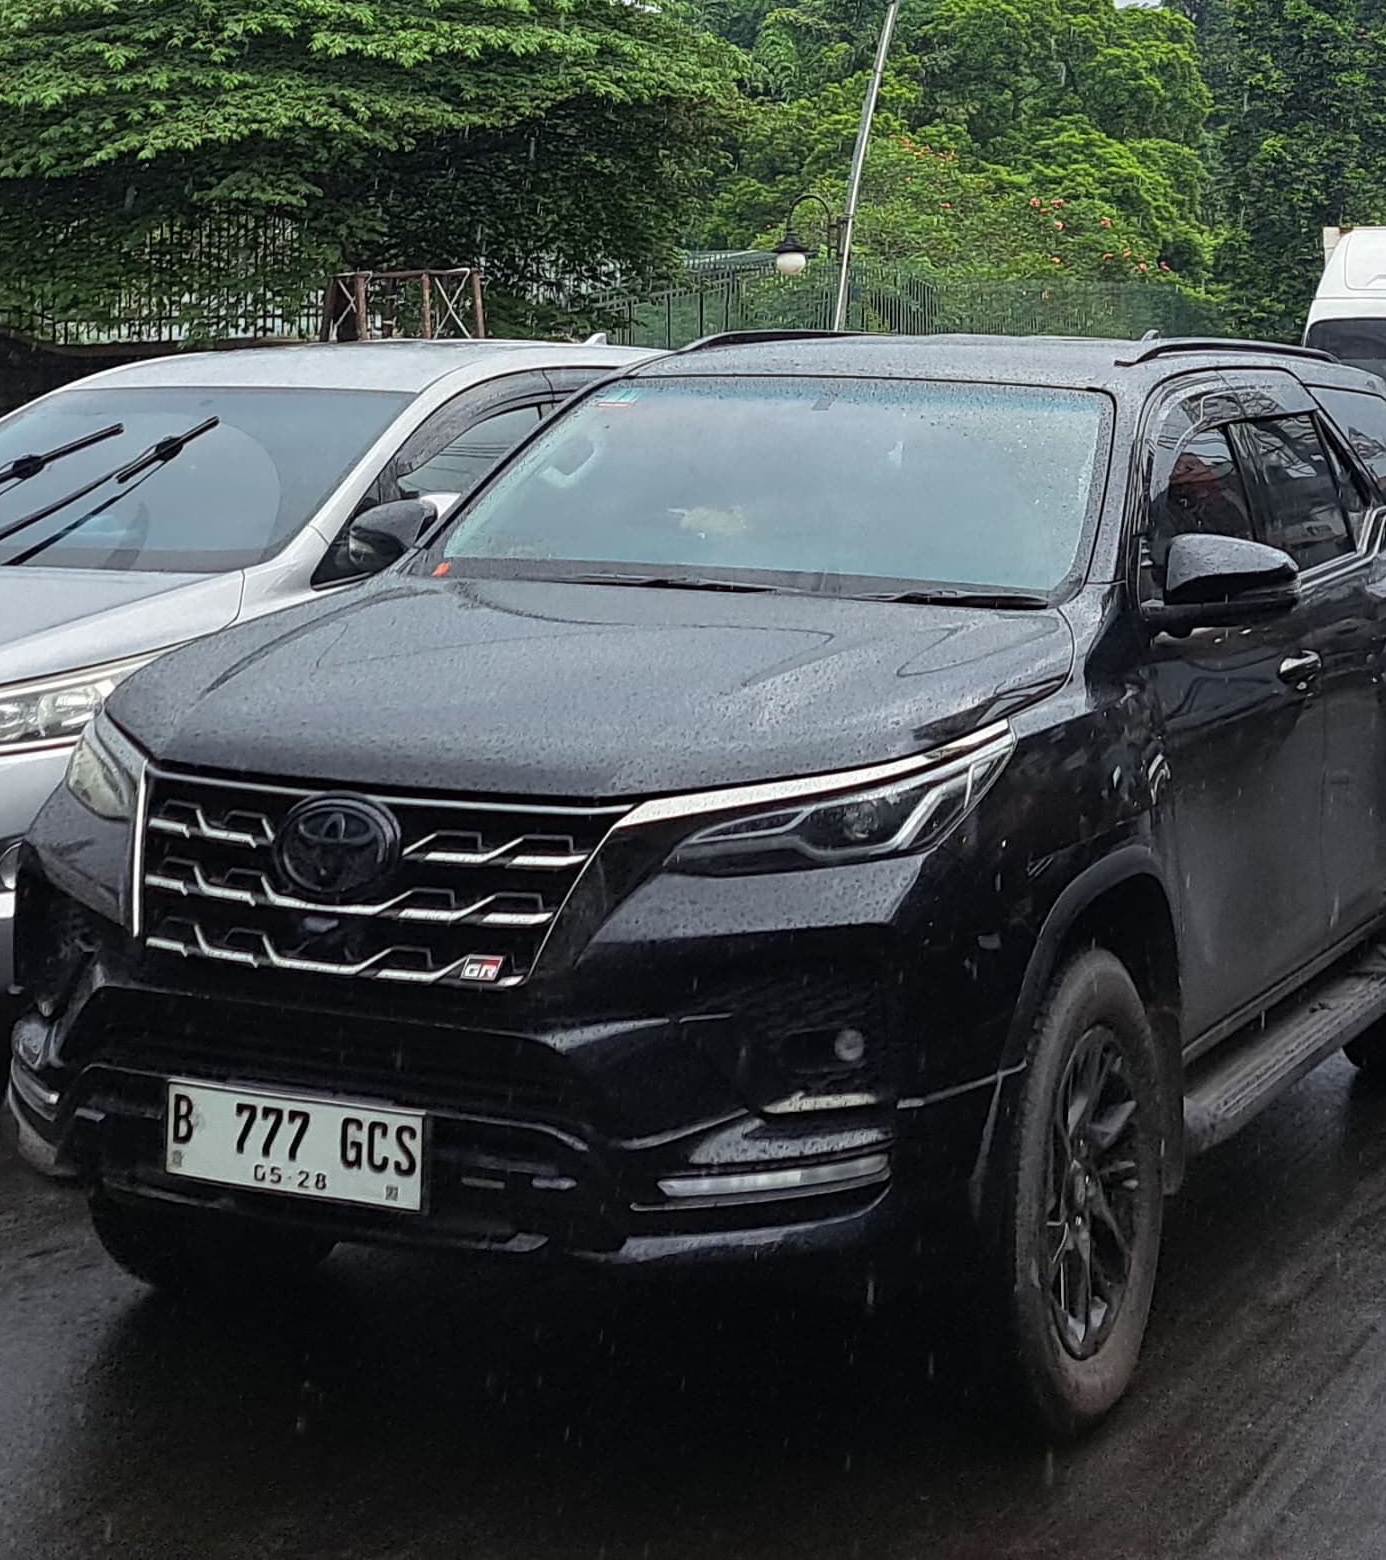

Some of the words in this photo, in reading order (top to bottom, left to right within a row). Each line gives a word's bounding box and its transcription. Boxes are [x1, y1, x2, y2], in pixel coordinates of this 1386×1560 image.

[172, 1093, 193, 1144] B
[235, 1102, 310, 1161] 777
[340, 1117, 417, 1177] GCS
